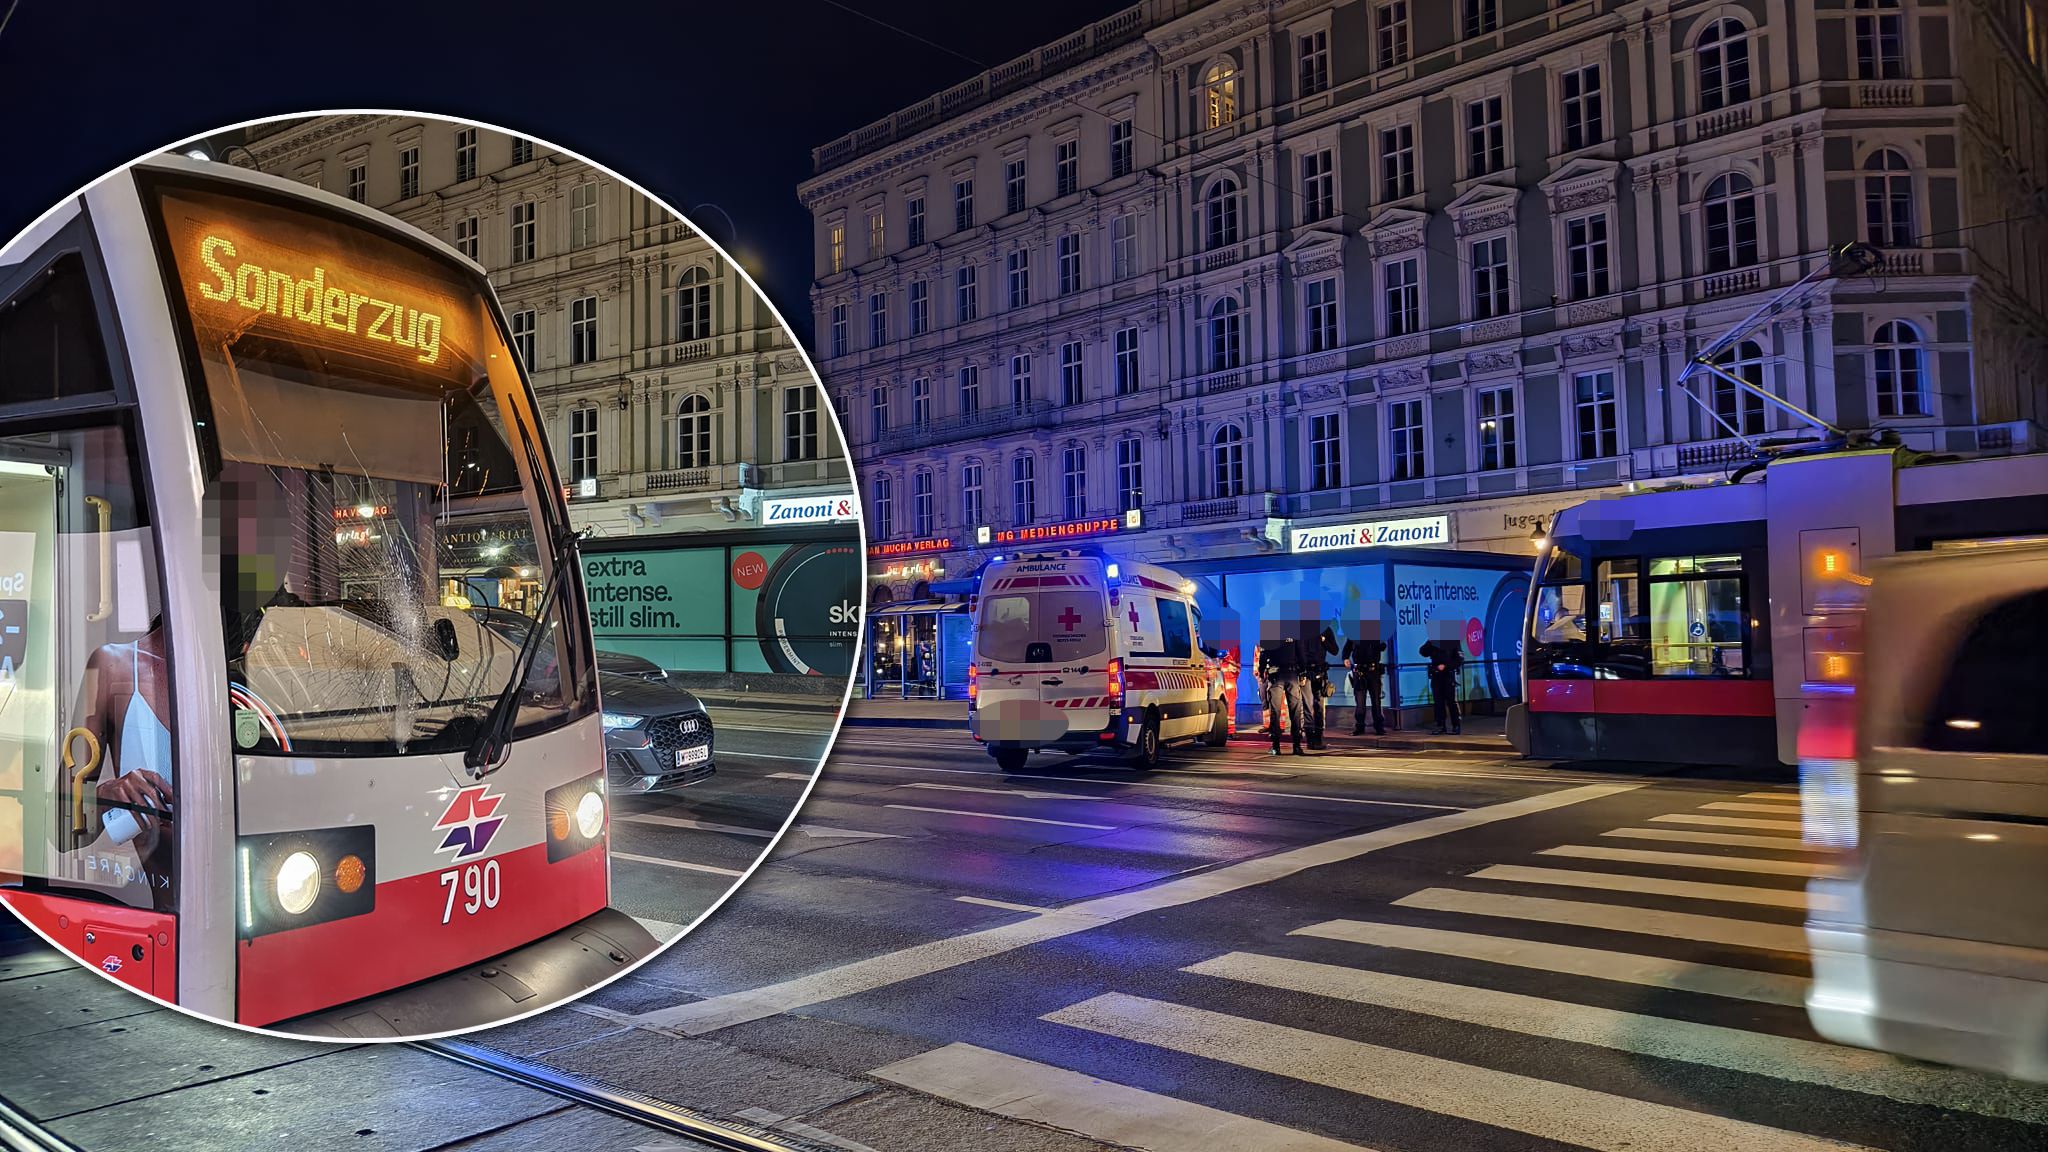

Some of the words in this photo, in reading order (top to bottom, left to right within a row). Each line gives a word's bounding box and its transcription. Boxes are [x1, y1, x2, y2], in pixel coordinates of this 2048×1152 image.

[199, 235, 442, 364] Sonderzug
[769, 500, 833, 520] Zanoni
[836, 499, 851, 516] &
[997, 531, 1014, 542] MG
[1020, 519, 1118, 540] MEDIENGRUPPE
[1298, 528, 1356, 549] Zanoni
[1359, 528, 1373, 544] &
[1376, 521, 1440, 543] Zanoni
[883, 543, 912, 553] MUCHA
[914, 538, 950, 551] VERLAG
[587, 557, 647, 577] extra
[736, 562, 764, 577] NEW
[1016, 563, 1067, 573] AMBULANCE
[587, 581, 673, 602] intense.
[1397, 581, 1432, 600] extra
[1434, 579, 1480, 601] intense.
[589, 605, 624, 628] still
[630, 605, 681, 628] slim.
[829, 599, 861, 623] sk
[1398, 603, 1421, 626] still
[1468, 630, 1483, 642] NEW
[440, 859, 501, 925] 790
